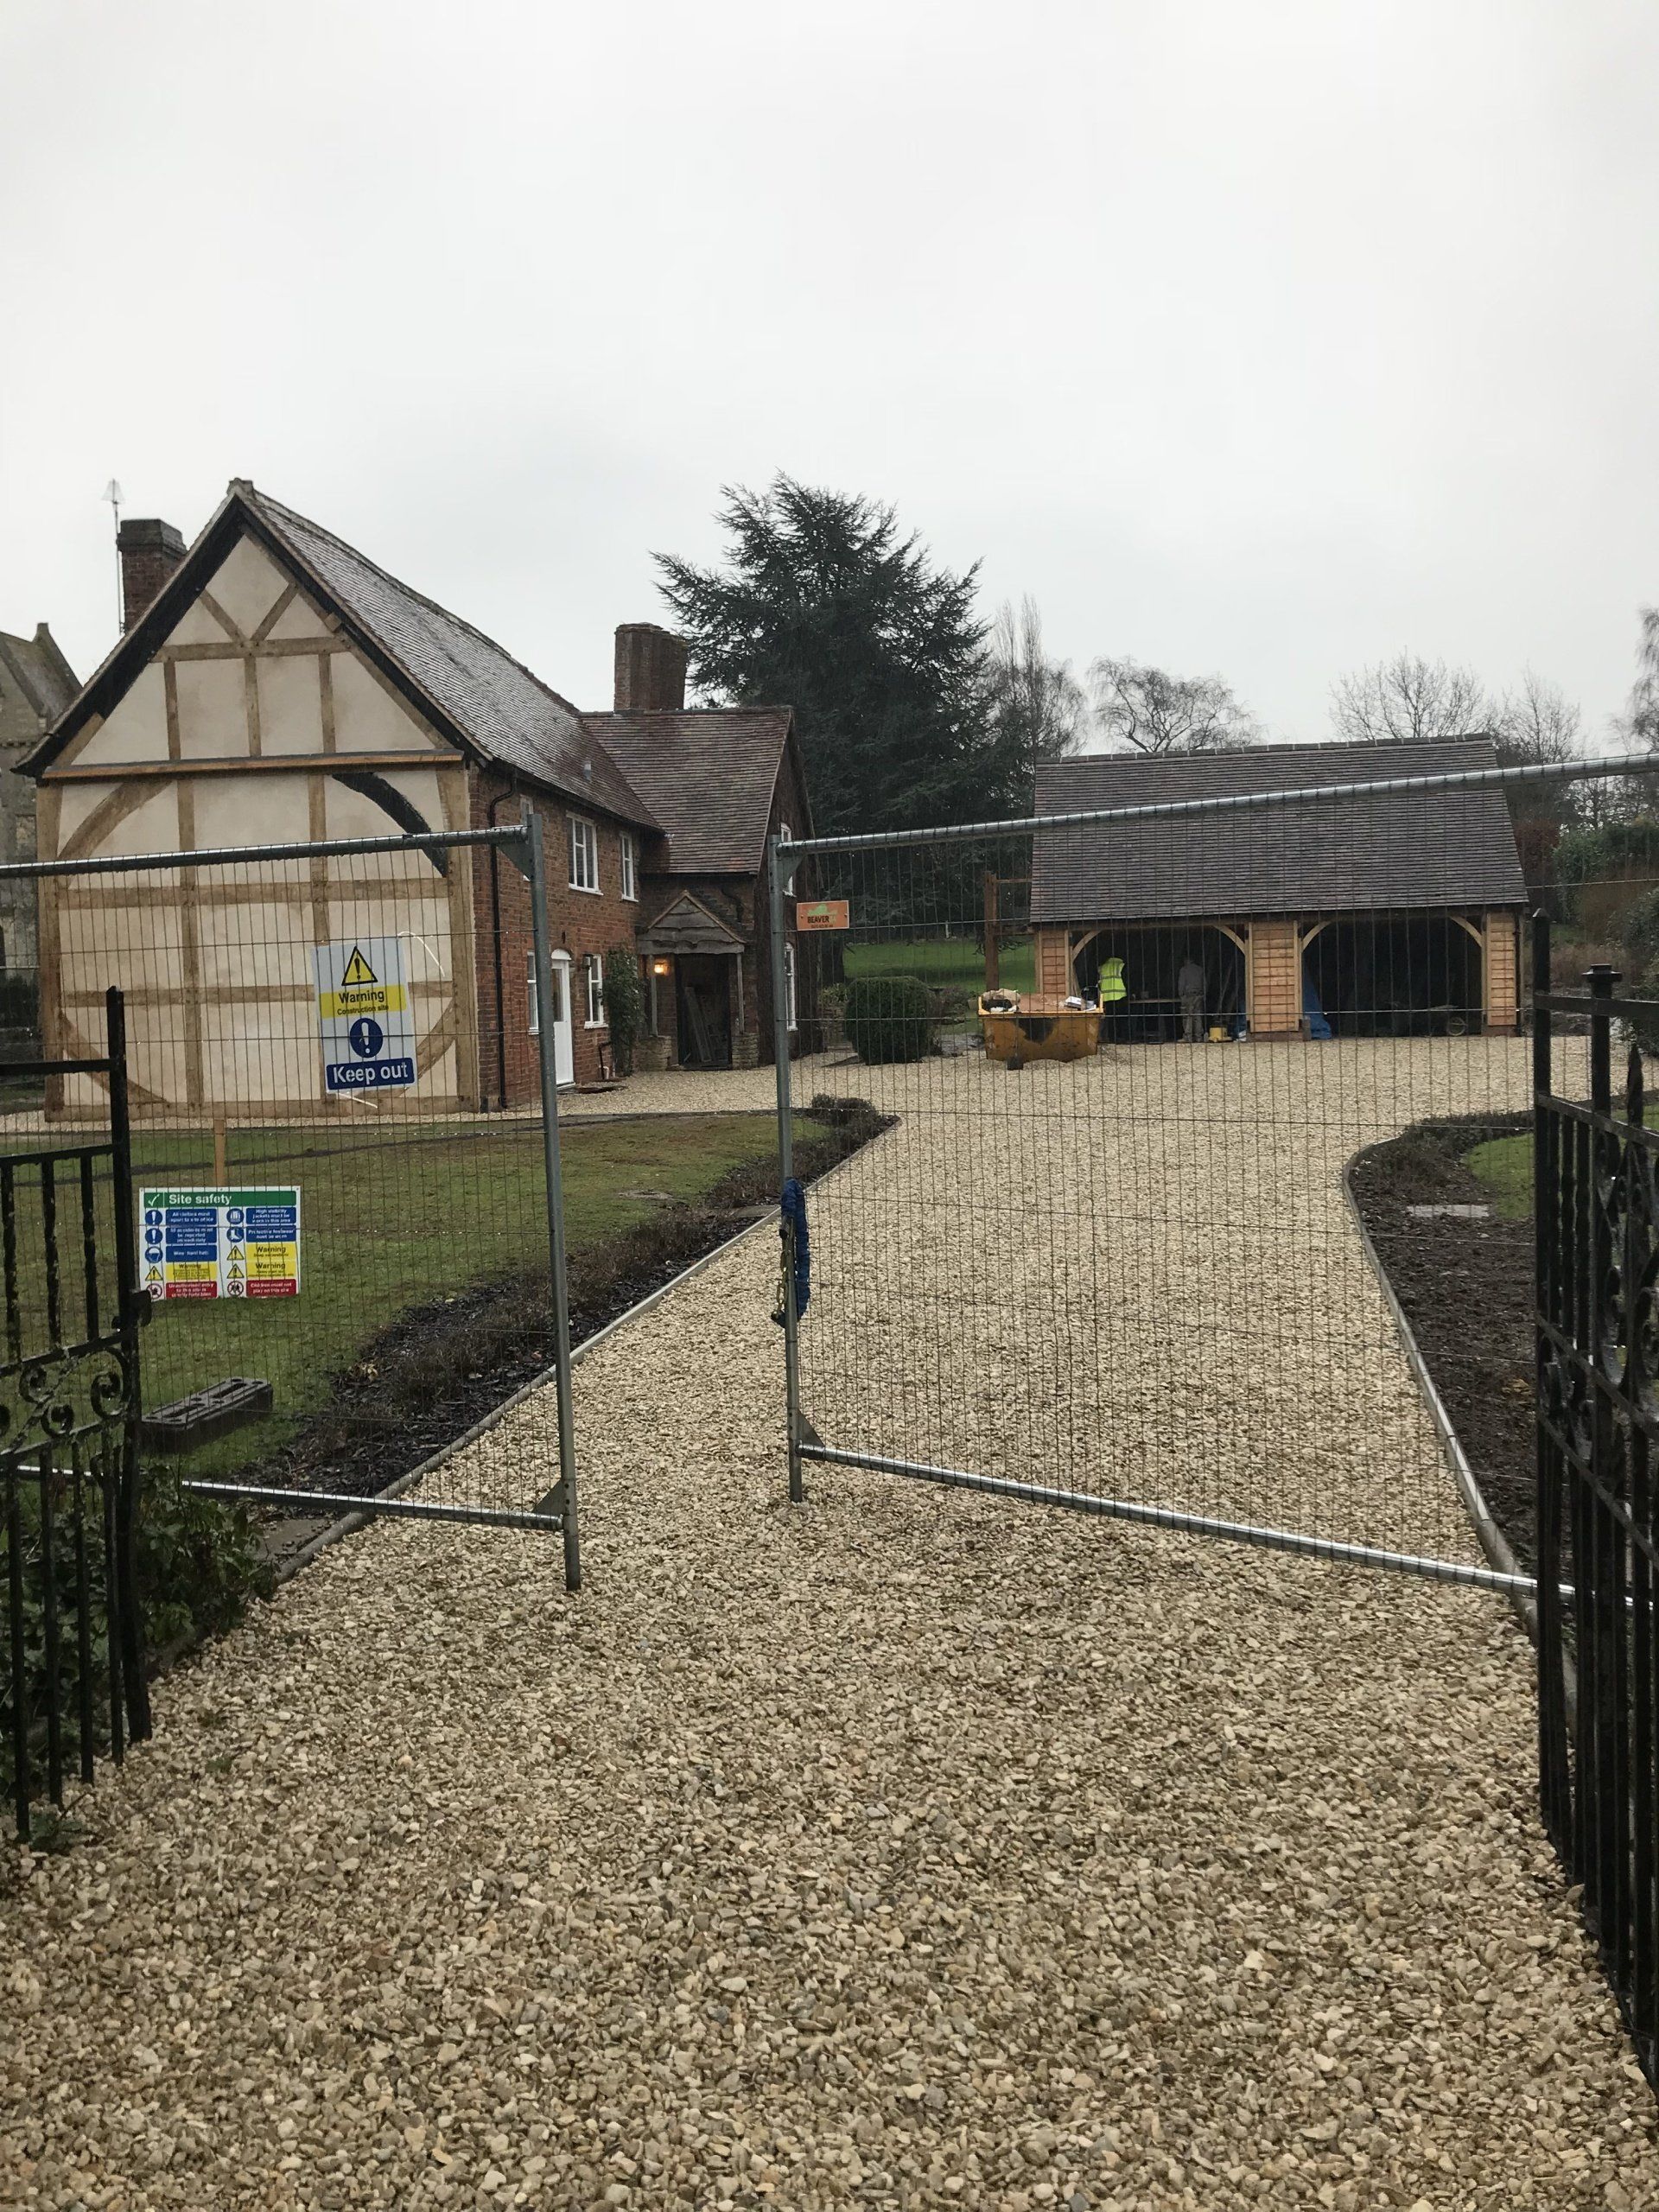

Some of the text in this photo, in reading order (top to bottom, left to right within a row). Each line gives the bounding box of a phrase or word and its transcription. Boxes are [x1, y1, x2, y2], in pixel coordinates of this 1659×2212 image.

[339, 989, 385, 1004] Warning
[337, 1006, 376, 1016] Construction
[333, 1061, 408, 1085] Keep out
[168, 1193, 232, 1205] Site safety
